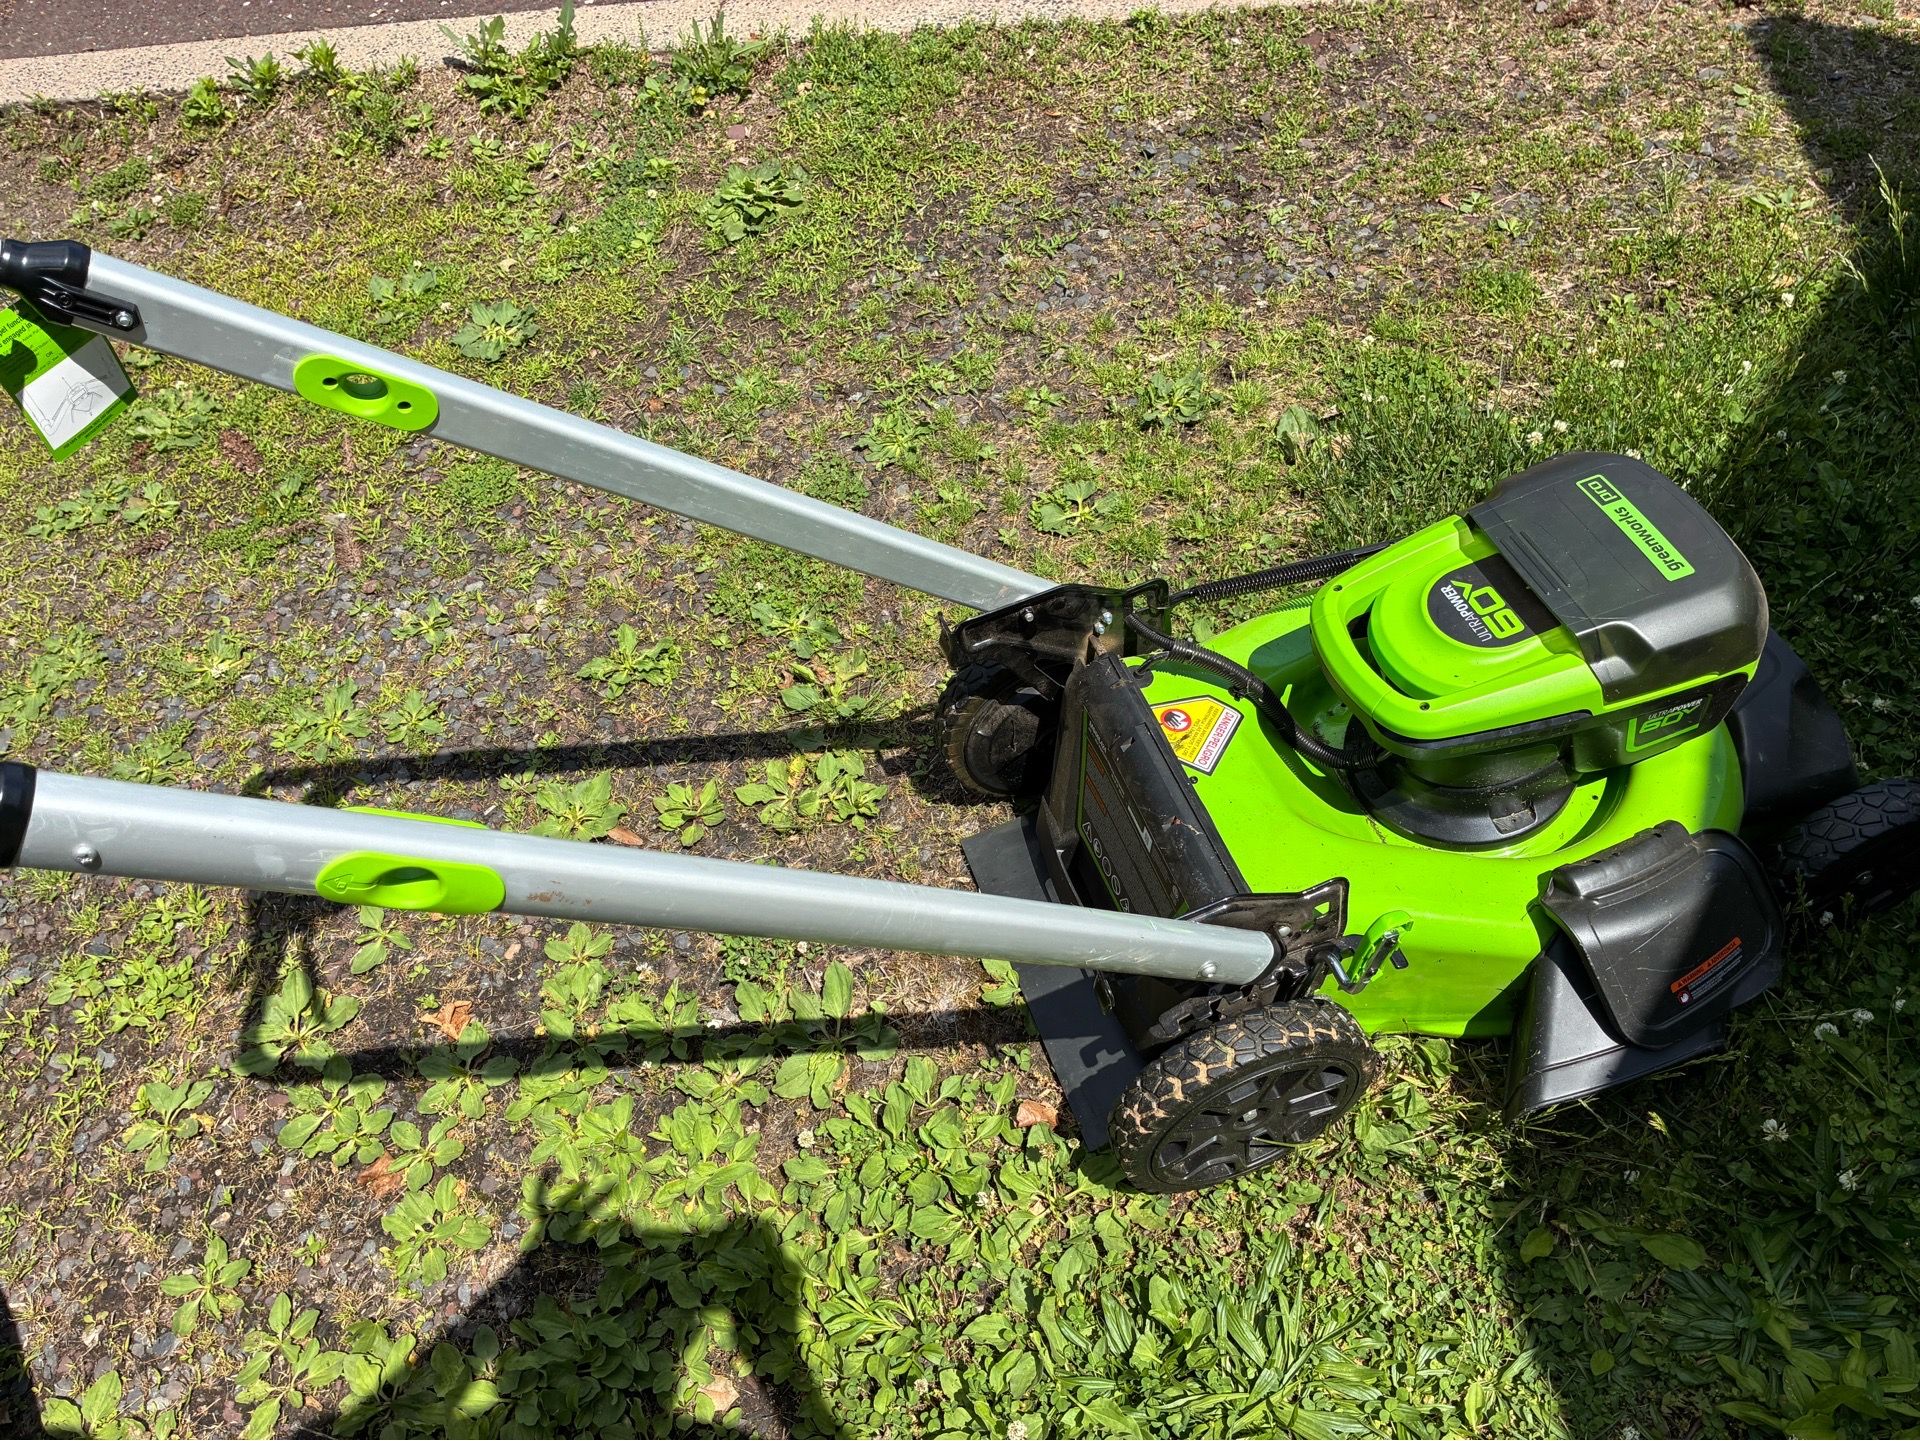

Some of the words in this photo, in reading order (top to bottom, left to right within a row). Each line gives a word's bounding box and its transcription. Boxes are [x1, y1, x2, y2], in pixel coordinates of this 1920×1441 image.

[2, 325, 27, 345] engaged
[1588, 481, 1618, 502] pro
[1614, 506, 1685, 572] greenworks
[1440, 585, 1492, 642] ULTRAPOWER
[1450, 580, 1525, 639] 60V
[1639, 704, 1700, 734] 60V
[1648, 698, 1703, 720] ULTRAPOWER
